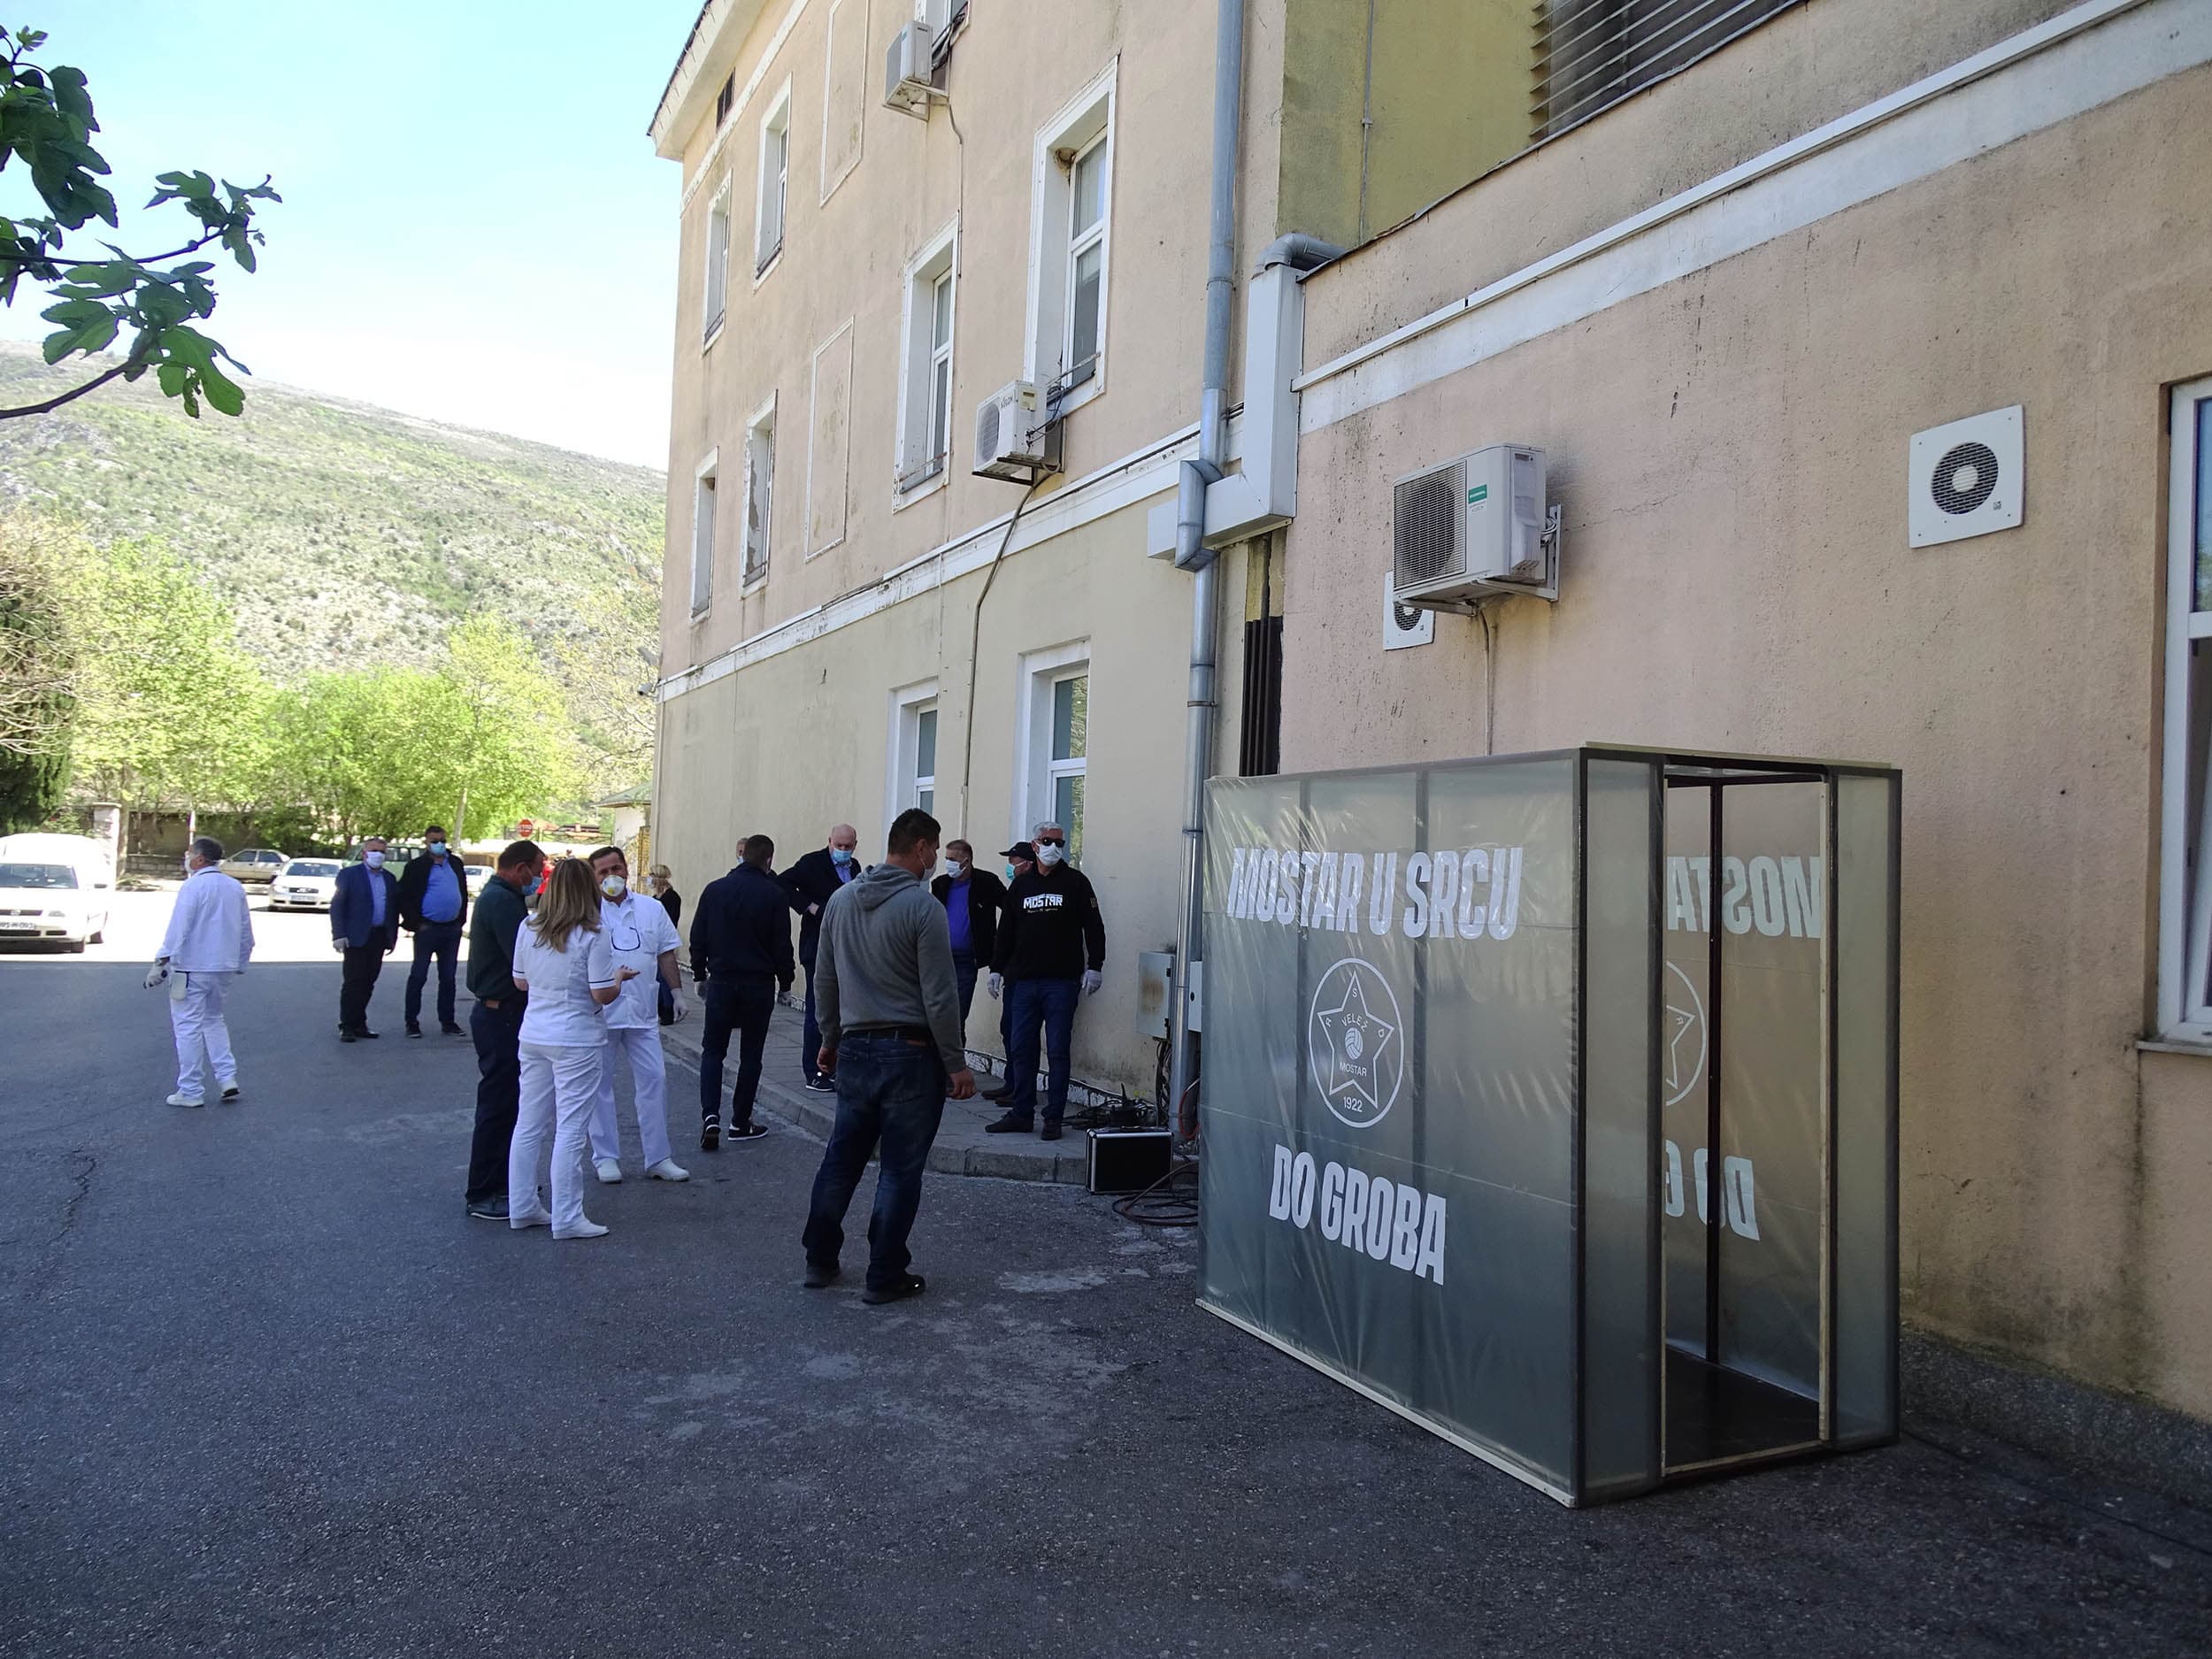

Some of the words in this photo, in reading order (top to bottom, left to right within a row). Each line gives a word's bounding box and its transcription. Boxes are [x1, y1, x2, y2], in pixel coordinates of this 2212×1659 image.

[1023, 894, 1063, 910] MOSTAR
[1227, 848, 1364, 933] MOSTAR
[1370, 851, 1397, 935] U
[1403, 847, 1523, 941] SRCU
[1352, 987, 1357, 998] S
[1341, 1013, 1368, 1033] VELEŽ
[1339, 1061, 1367, 1077] MOSTAR
[1343, 1095, 1363, 1112] 1922
[1269, 1143, 1316, 1229] DO
[1320, 1161, 1447, 1286] GROBA
